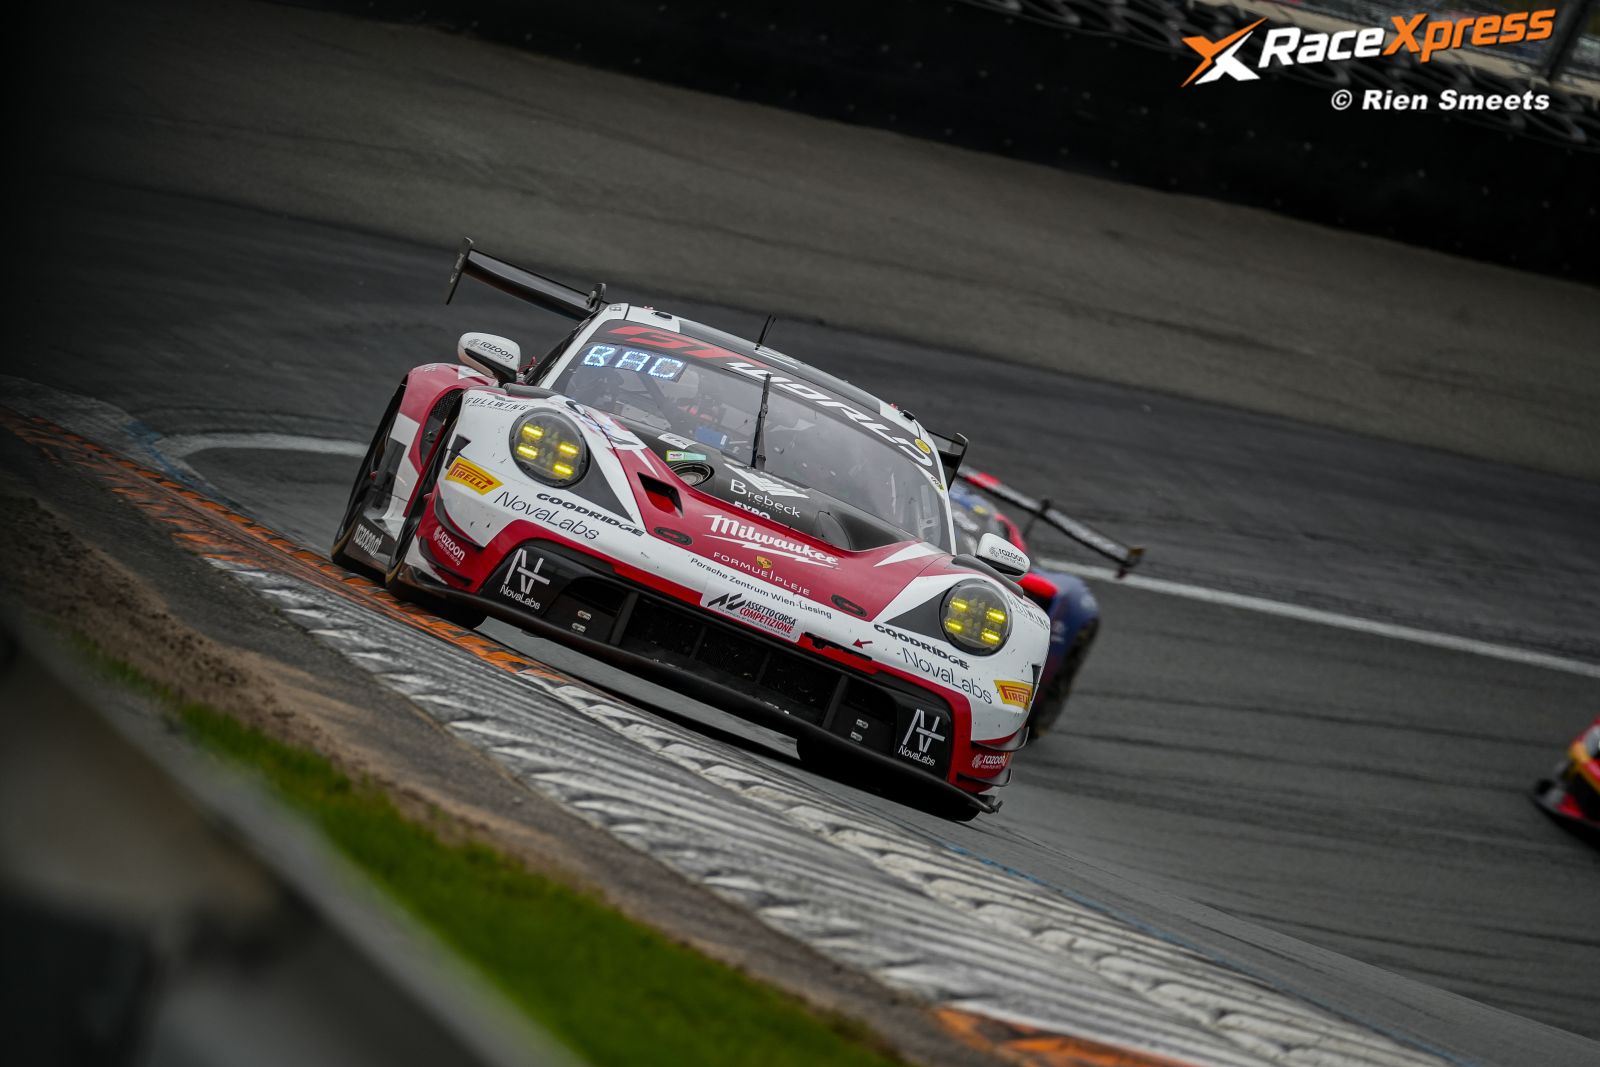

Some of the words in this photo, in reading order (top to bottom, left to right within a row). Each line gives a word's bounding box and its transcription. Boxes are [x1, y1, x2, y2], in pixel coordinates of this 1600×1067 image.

[480, 341, 514, 360] razoon
[464, 396, 529, 411] GULLWING
[725, 361, 934, 467] WORLD
[449, 462, 495, 491] PIRELLI
[493, 490, 600, 541] NovaLabs
[536, 493, 645, 537] GOODRIDGE
[730, 478, 801, 518] Brebeck
[439, 531, 466, 561] razoon
[703, 514, 840, 566] Milwaukee
[690, 556, 728, 580] Porsche
[729, 574, 770, 597] Zentrum
[770, 592, 833, 620] Wien-Liesing
[713, 551, 769, 578] FORMUE
[774, 576, 811, 596] PLEJE
[499, 583, 541, 610] NovaLabs
[744, 601, 776, 618] ASSETTO
[773, 609, 798, 627] CORSA
[739, 606, 795, 635] COMPETIZIONE
[873, 623, 970, 671] GOODRIDGE
[902, 647, 993, 705] NovaLabs
[898, 744, 936, 767] NovaLabs
